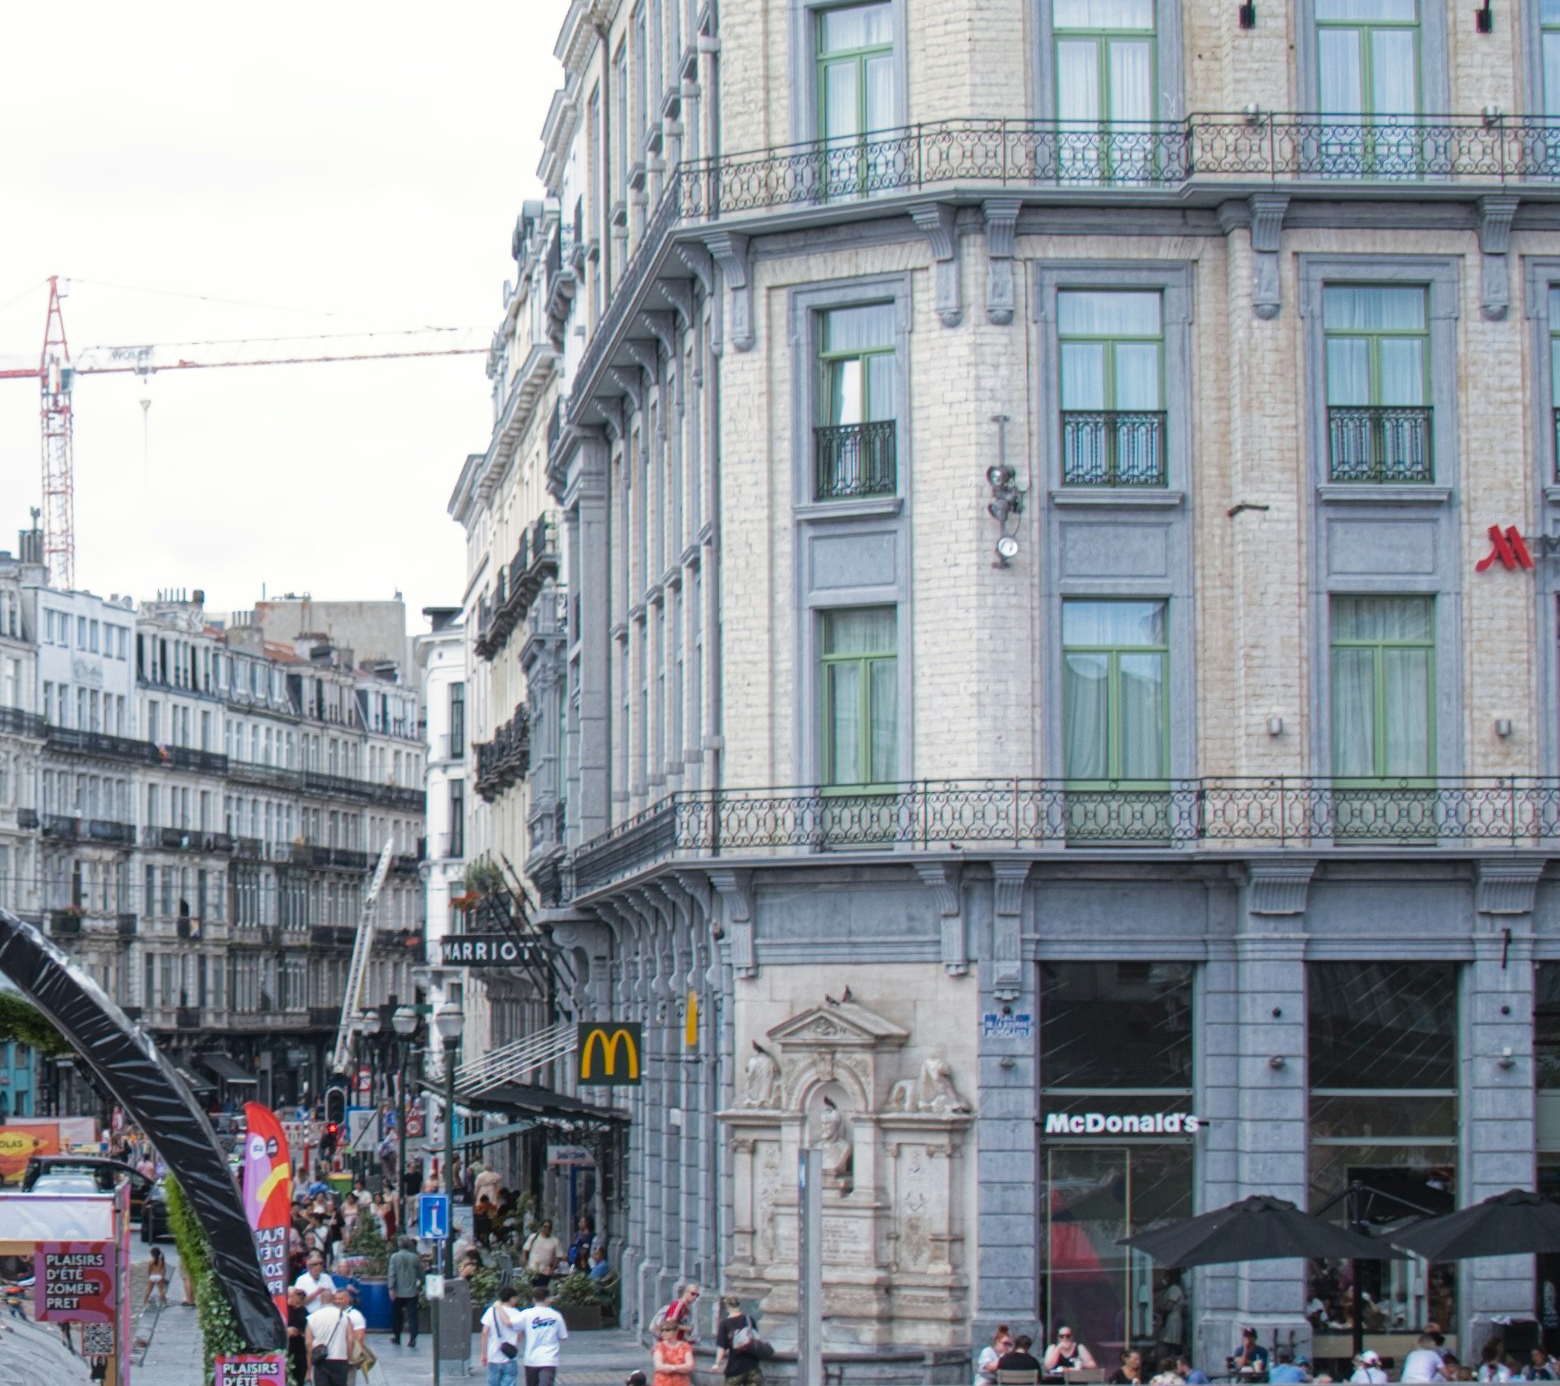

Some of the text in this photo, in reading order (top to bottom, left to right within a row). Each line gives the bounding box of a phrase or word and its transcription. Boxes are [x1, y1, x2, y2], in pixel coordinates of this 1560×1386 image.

[1045, 1113, 1200, 1133] McDonald's
[46, 1254, 104, 1265] PLAISIRS
[46, 1266, 84, 1280] D'ÉTÉ
[46, 1283, 99, 1294] ZOMER-
[46, 1297, 79, 1309] PRET
[222, 1363, 278, 1374] PLAISIRS
